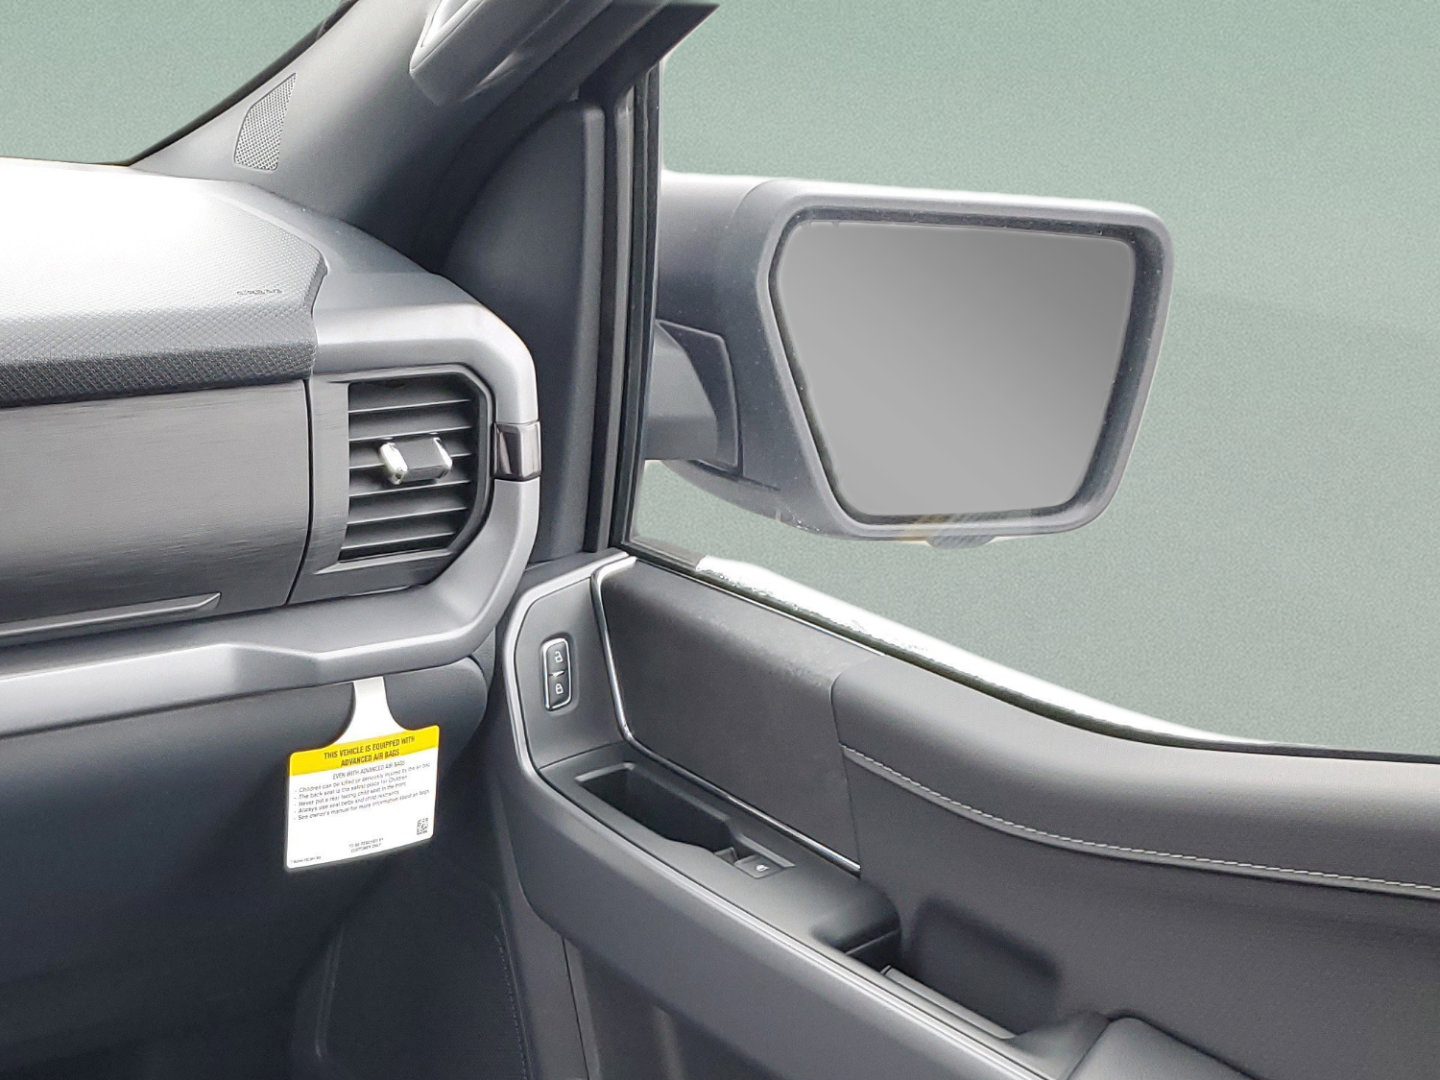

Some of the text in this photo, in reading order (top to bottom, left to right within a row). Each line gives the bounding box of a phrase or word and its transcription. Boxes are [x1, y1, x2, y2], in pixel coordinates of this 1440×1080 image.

[324, 752, 338, 760] THIS
[340, 746, 364, 758] VEHICLE
[372, 738, 400, 751] EQUIPPED
[401, 735, 415, 745] WITH
[341, 749, 400, 767] ADVANCED AIR BAGS
